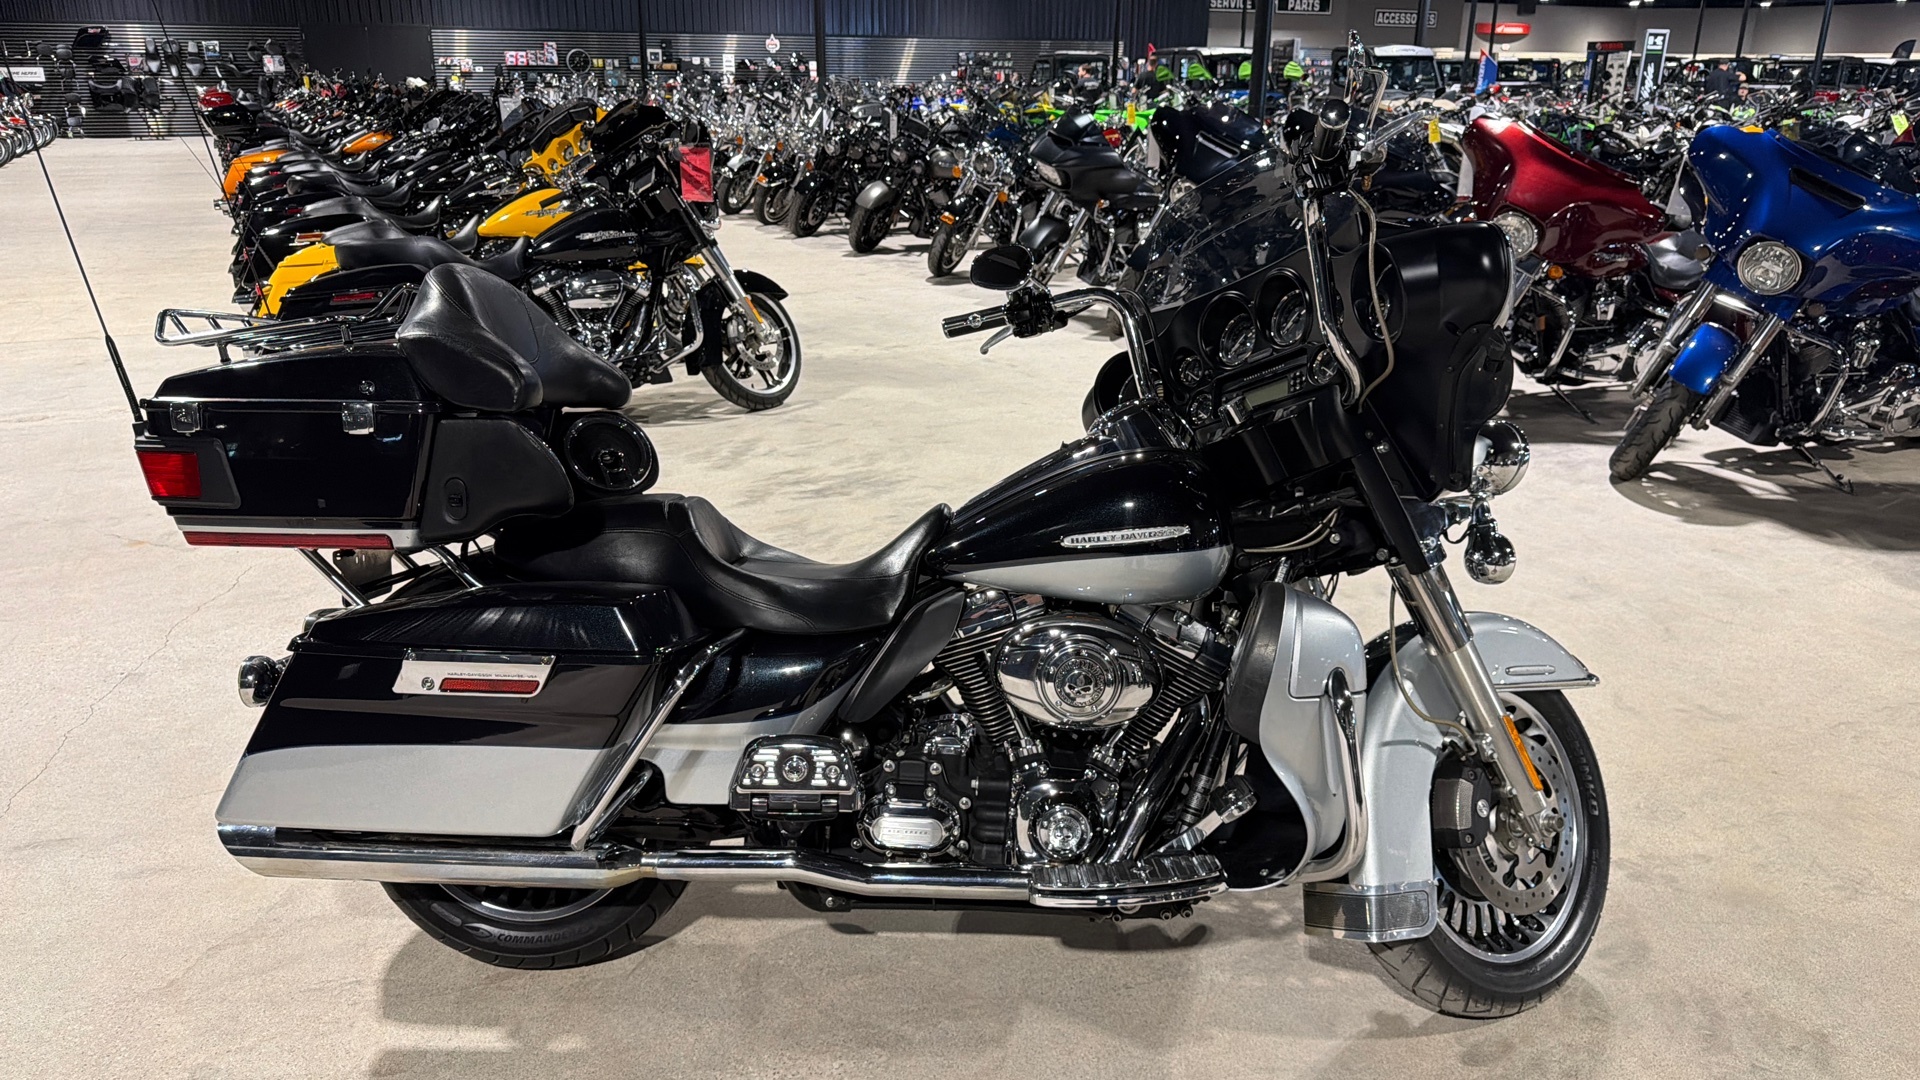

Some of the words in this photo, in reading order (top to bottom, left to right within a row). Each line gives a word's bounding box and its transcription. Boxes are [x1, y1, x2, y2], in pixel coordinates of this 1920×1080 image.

[1288, 0, 1320, 11] PARTS
[1377, 12, 1435, 25] ACCESSOS
[1070, 528, 1180, 544] HARLEY-DAVIDSON
[497, 927, 574, 945] COMMANDE
